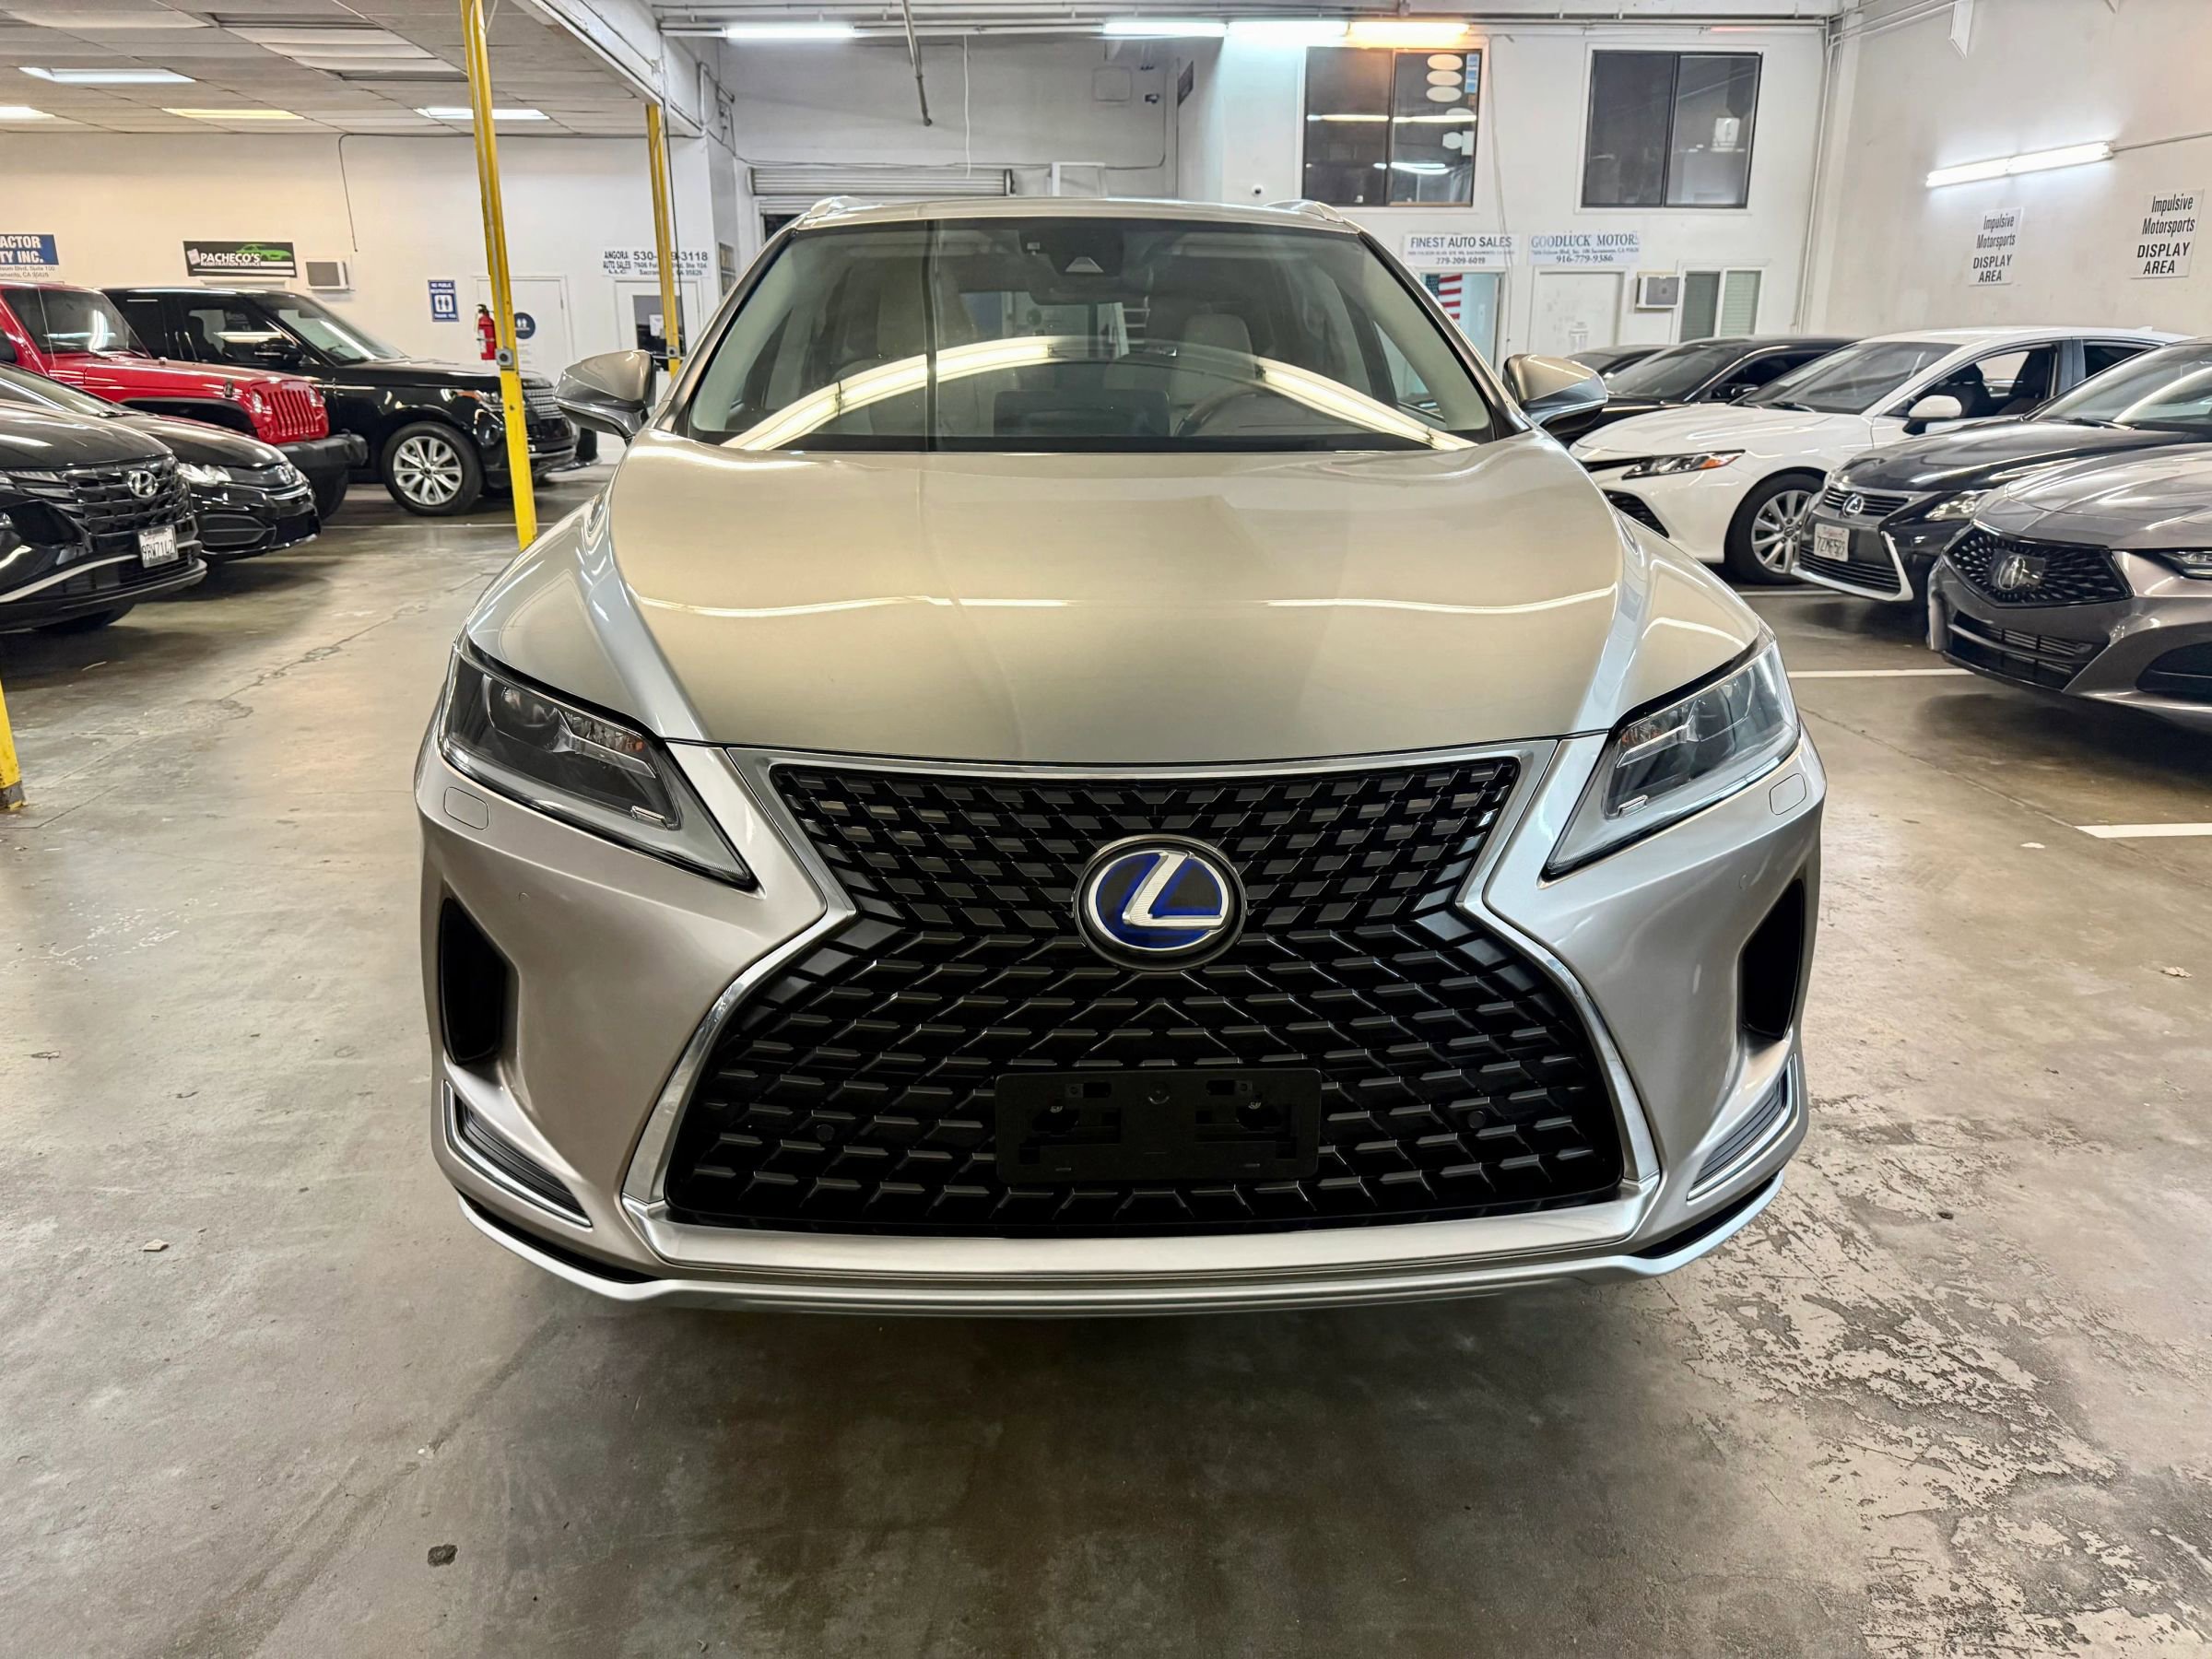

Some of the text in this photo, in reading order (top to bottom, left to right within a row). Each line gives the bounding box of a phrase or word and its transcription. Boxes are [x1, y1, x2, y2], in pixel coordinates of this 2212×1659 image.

[2151, 193, 2194, 217] Impulsive
[1983, 213, 2015, 233] Impulsive
[2142, 217, 2195, 238] Motorsports
[0, 236, 41, 249] ACTOR
[1410, 237, 1512, 248] FINEST AUTO SALES
[1531, 234, 1592, 248] GOODLUCK
[1976, 233, 2017, 251] Motorsports
[605, 251, 629, 259] ANGORA
[633, 251, 708, 262] 530-9-3118
[2137, 241, 2191, 258] DISPLAY
[17, 251, 44, 264] INC.
[200, 253, 261, 263] PACHECO'S
[1973, 253, 2012, 269] DISPLAY
[2143, 260, 2175, 275] AREA
[1978, 269, 2002, 283] AREA
